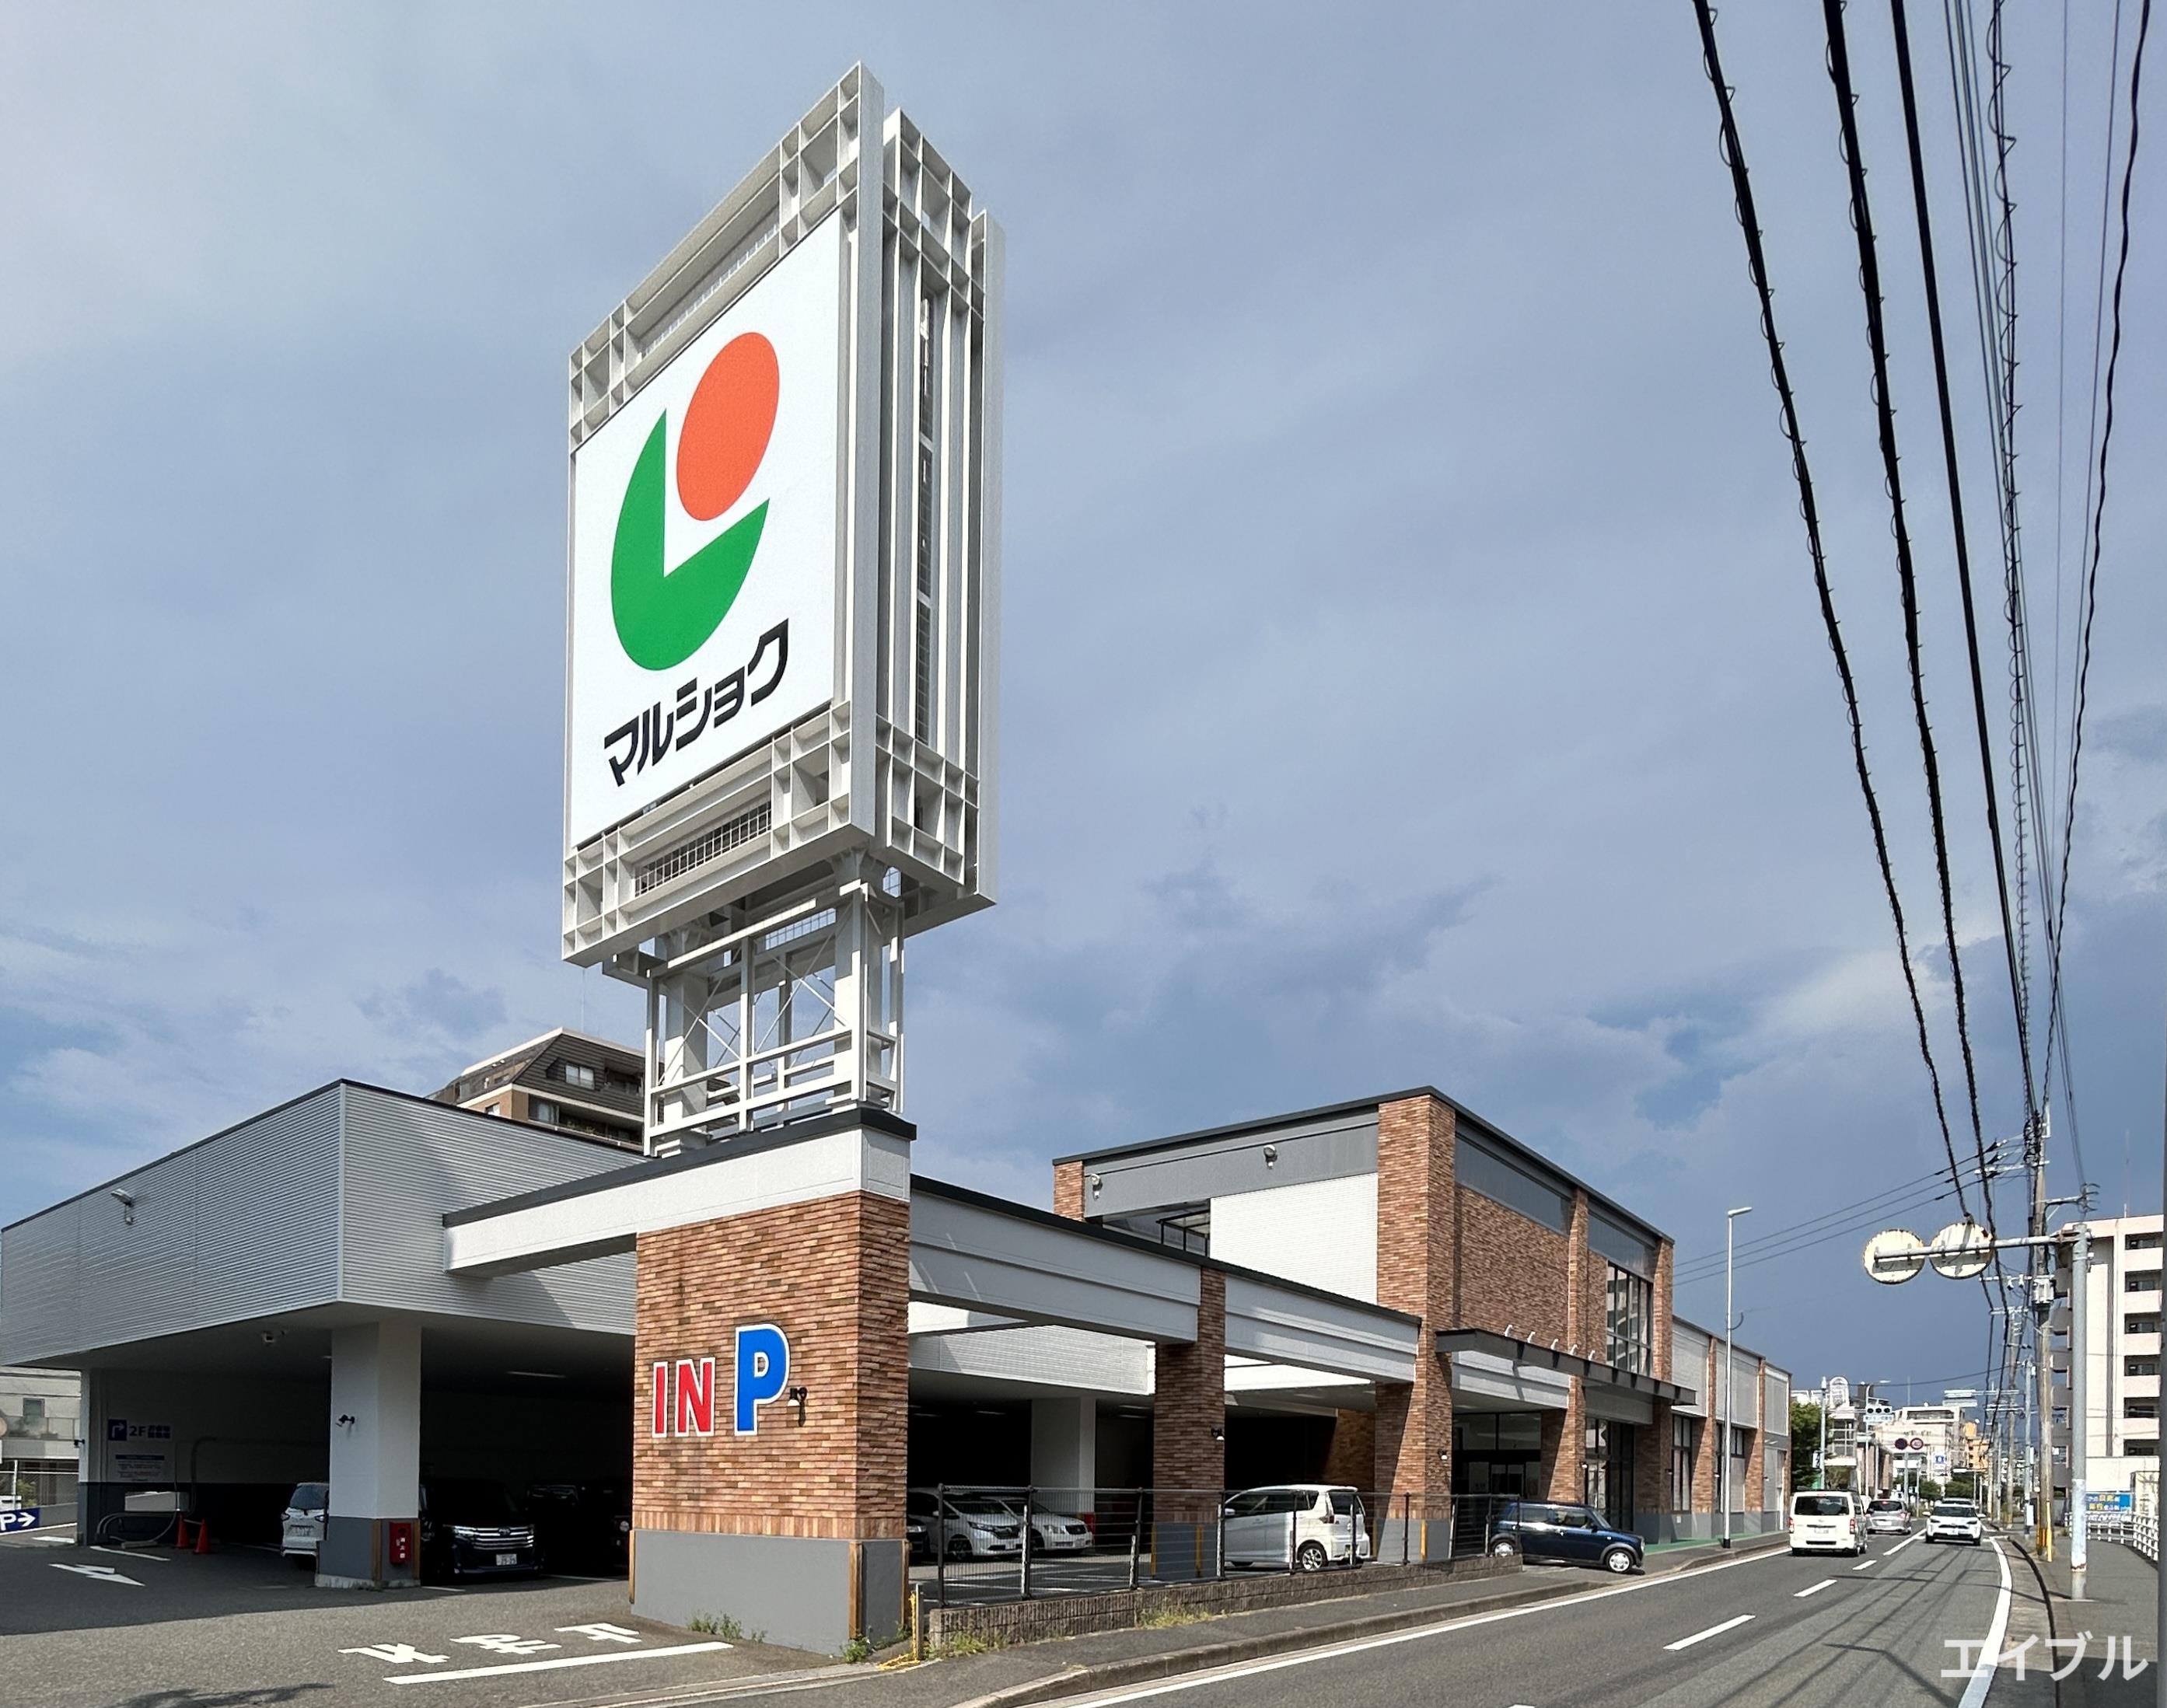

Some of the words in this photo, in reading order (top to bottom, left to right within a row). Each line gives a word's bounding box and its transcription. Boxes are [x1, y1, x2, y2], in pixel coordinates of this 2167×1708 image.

[604, 618, 788, 787] マルショク
[652, 1357, 715, 1437] IN
[734, 1323, 790, 1436] P
[0, 1513, 16, 1531] P
[337, 1622, 641, 1664] 止まれ
